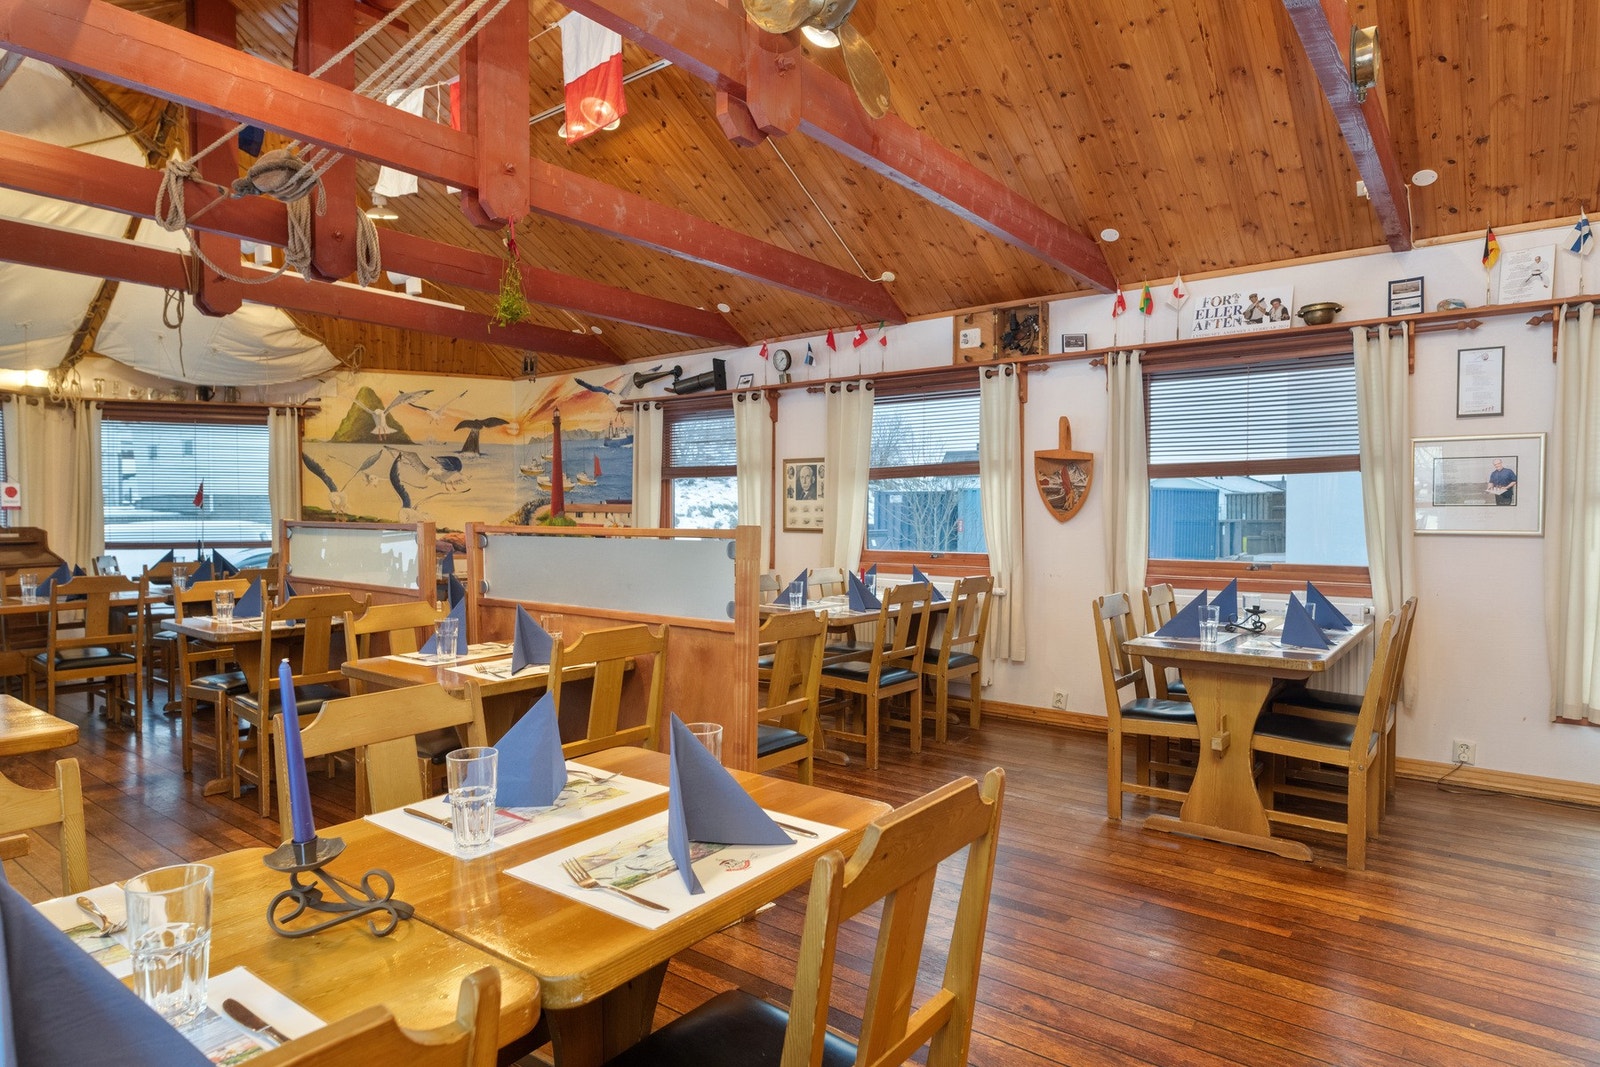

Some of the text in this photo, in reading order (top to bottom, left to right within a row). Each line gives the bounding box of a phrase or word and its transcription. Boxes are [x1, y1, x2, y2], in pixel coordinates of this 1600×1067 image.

[1202, 294, 1232, 308] FOR
[1195, 304, 1243, 320] ELLER
[1193, 315, 1243, 331] AFTEN
